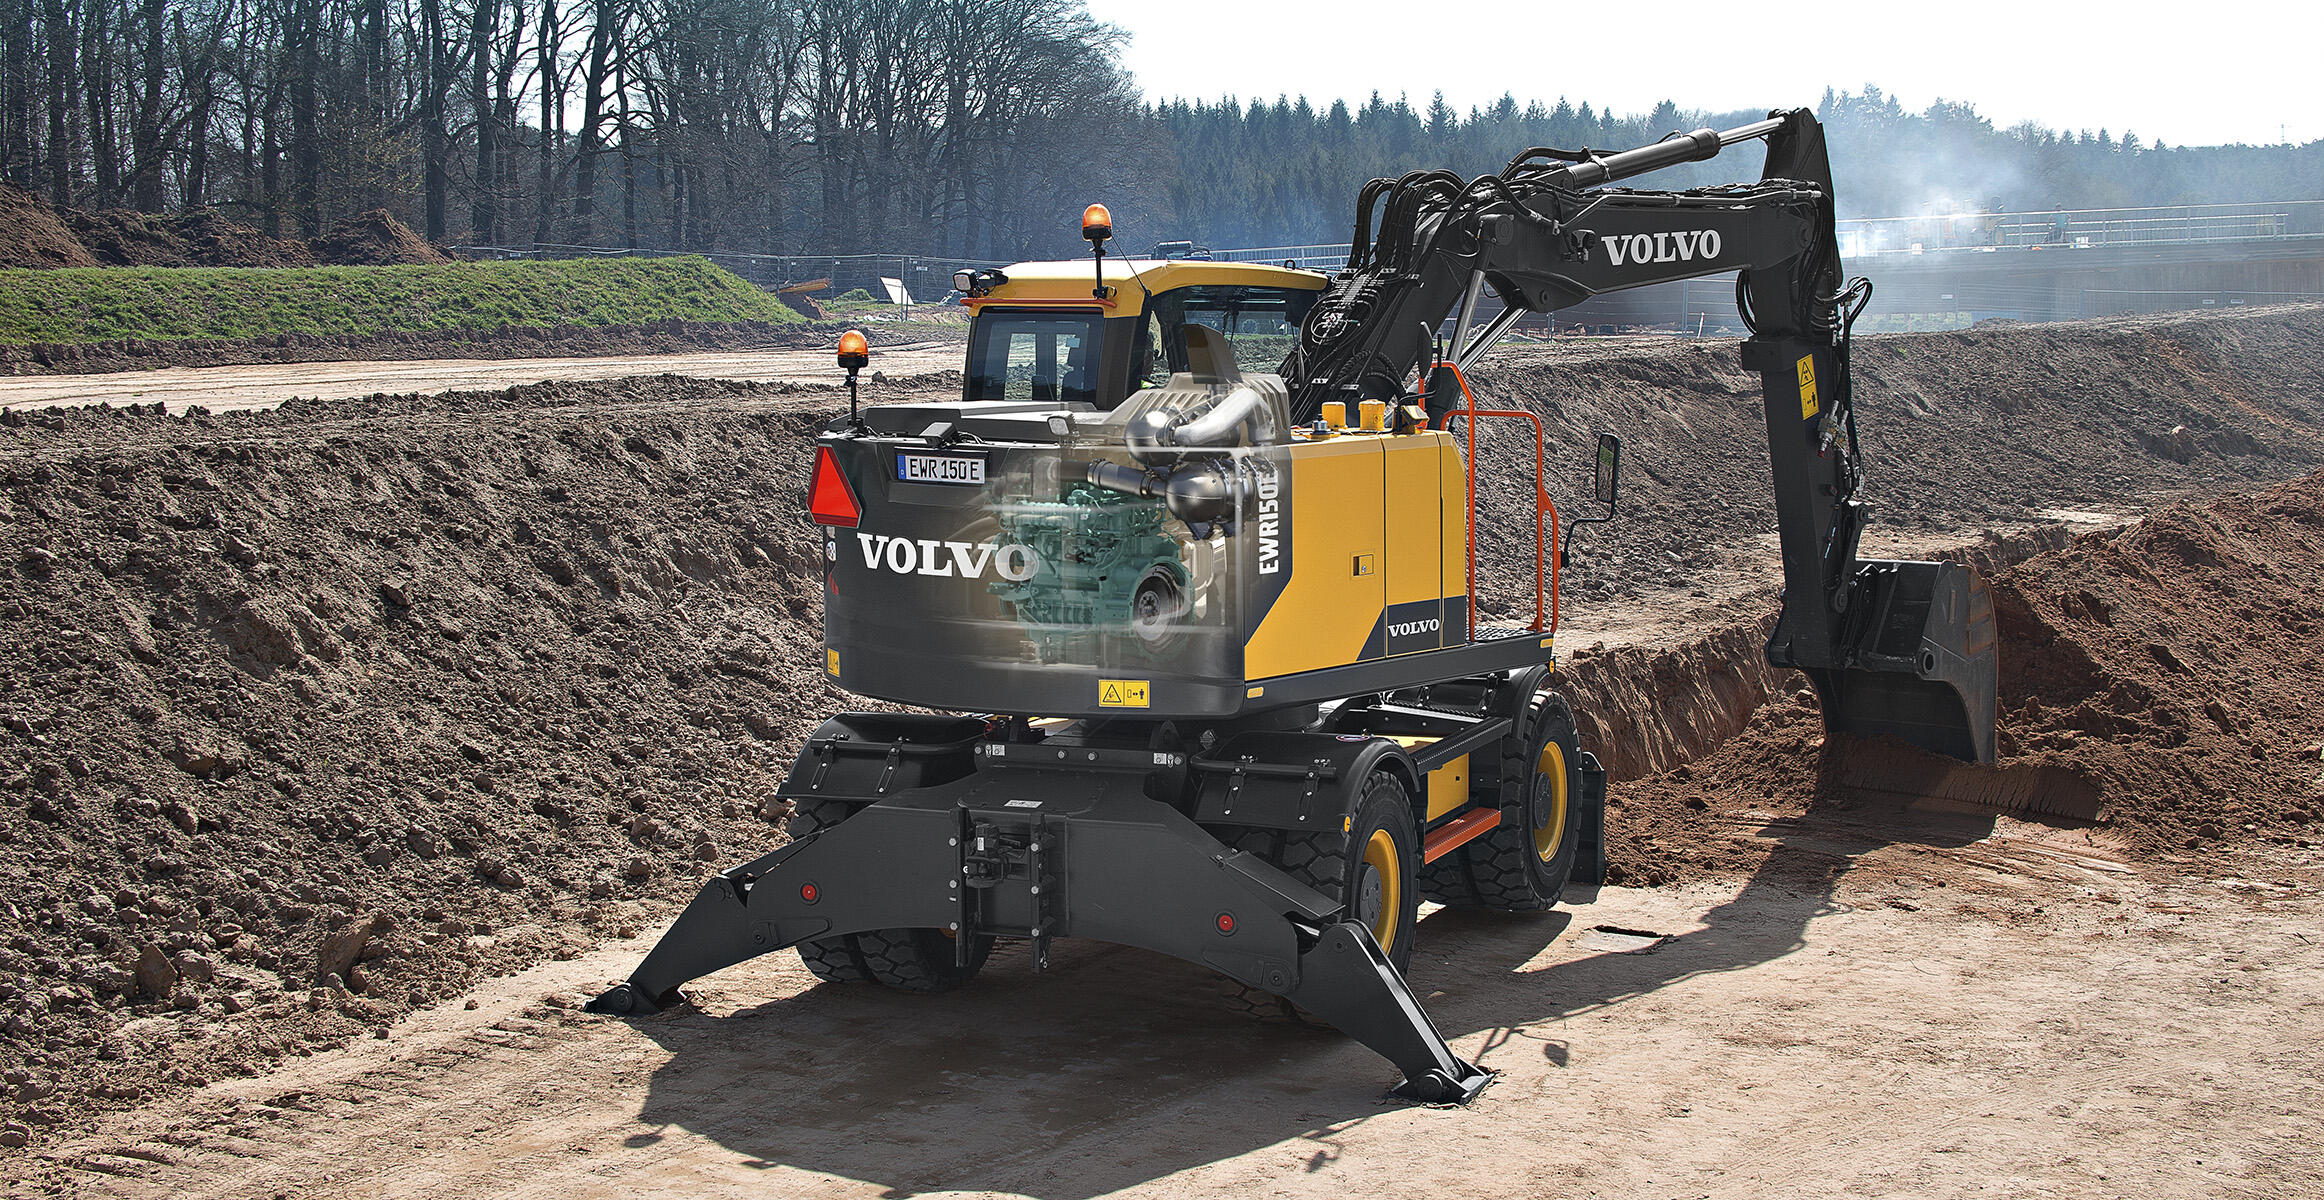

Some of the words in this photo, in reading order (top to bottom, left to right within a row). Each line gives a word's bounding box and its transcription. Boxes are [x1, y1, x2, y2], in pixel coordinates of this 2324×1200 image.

[1601, 229, 1721, 266] VOLVO
[909, 458, 938, 479] EWR
[941, 460, 967, 480] 150
[970, 461, 980, 481] E
[1259, 470, 1279, 575] EWR150E
[857, 532, 1039, 582] VOLVO
[1387, 618, 1440, 638] VOLVO
